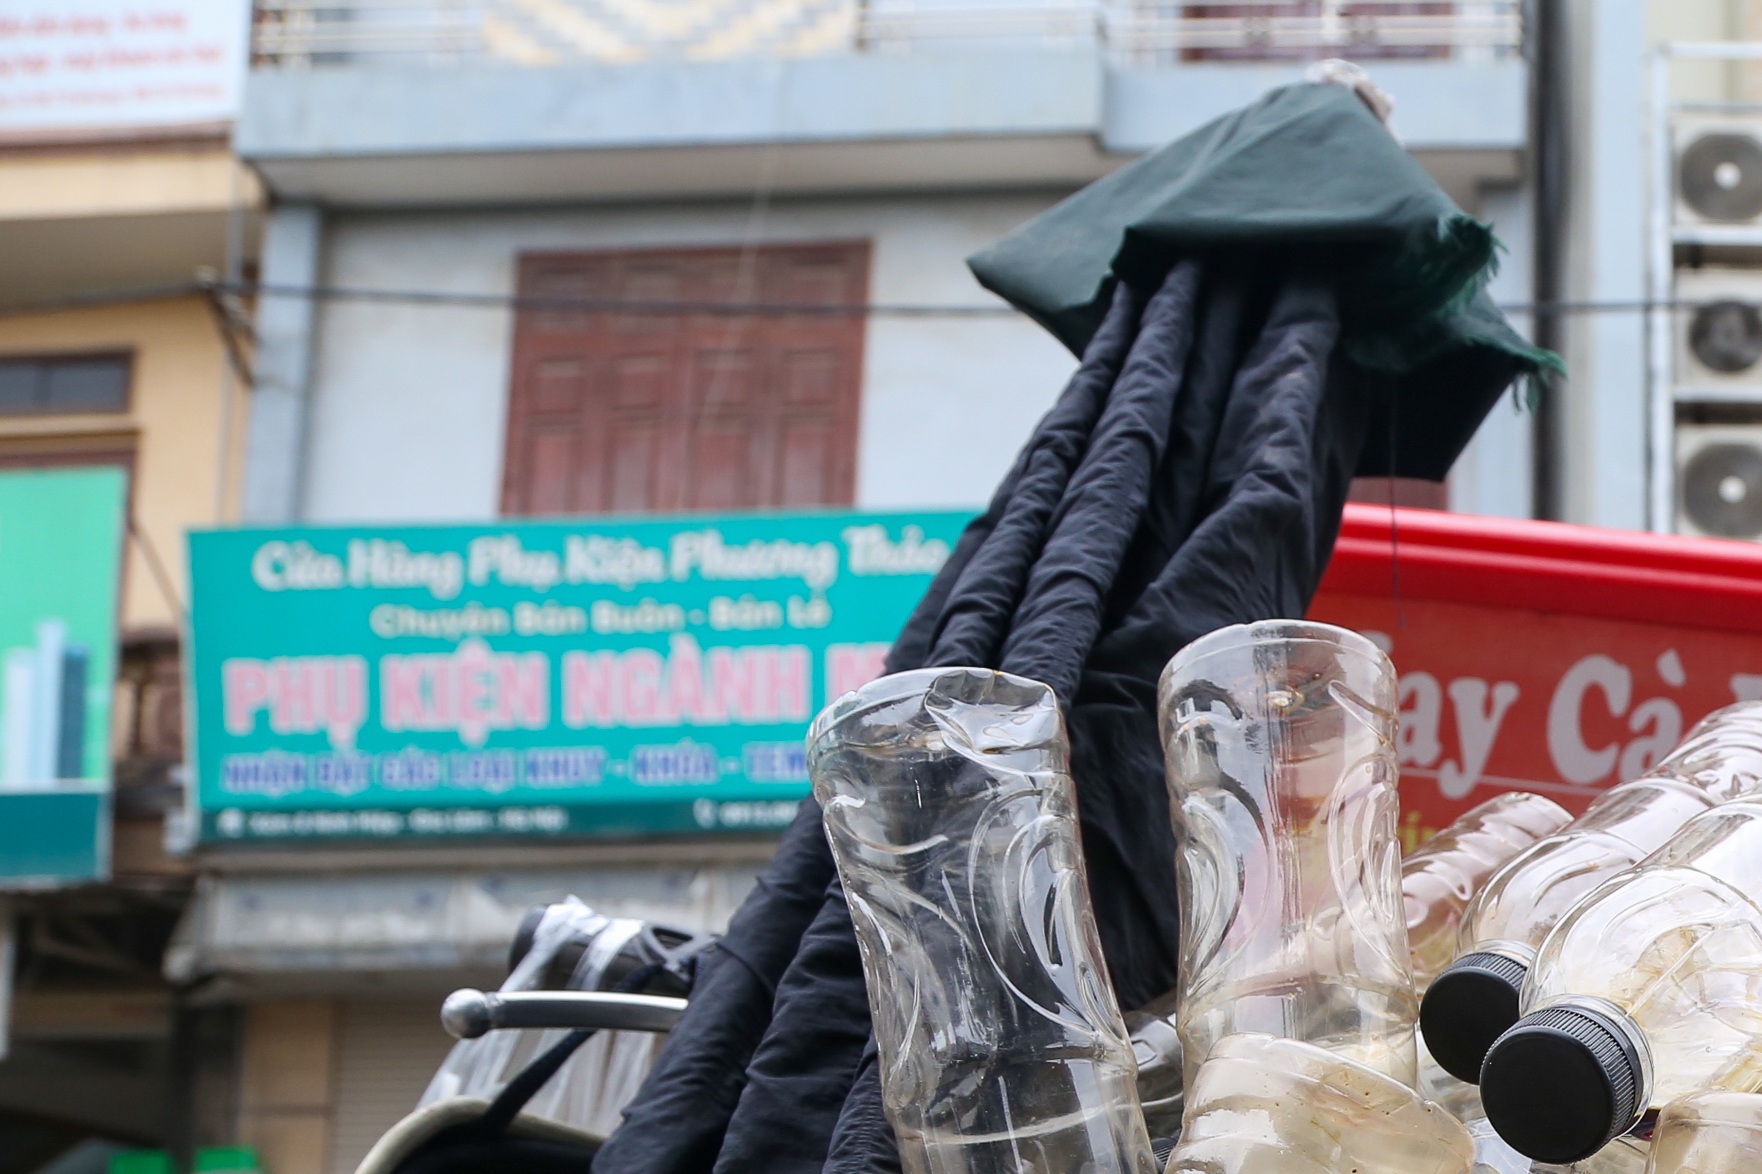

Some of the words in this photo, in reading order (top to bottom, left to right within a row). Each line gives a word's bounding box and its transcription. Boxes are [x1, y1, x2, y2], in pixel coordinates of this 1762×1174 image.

[222, 655, 370, 752] PHỤ
[379, 635, 550, 748] KIỆN
[561, 632, 812, 730] NGÀNH
